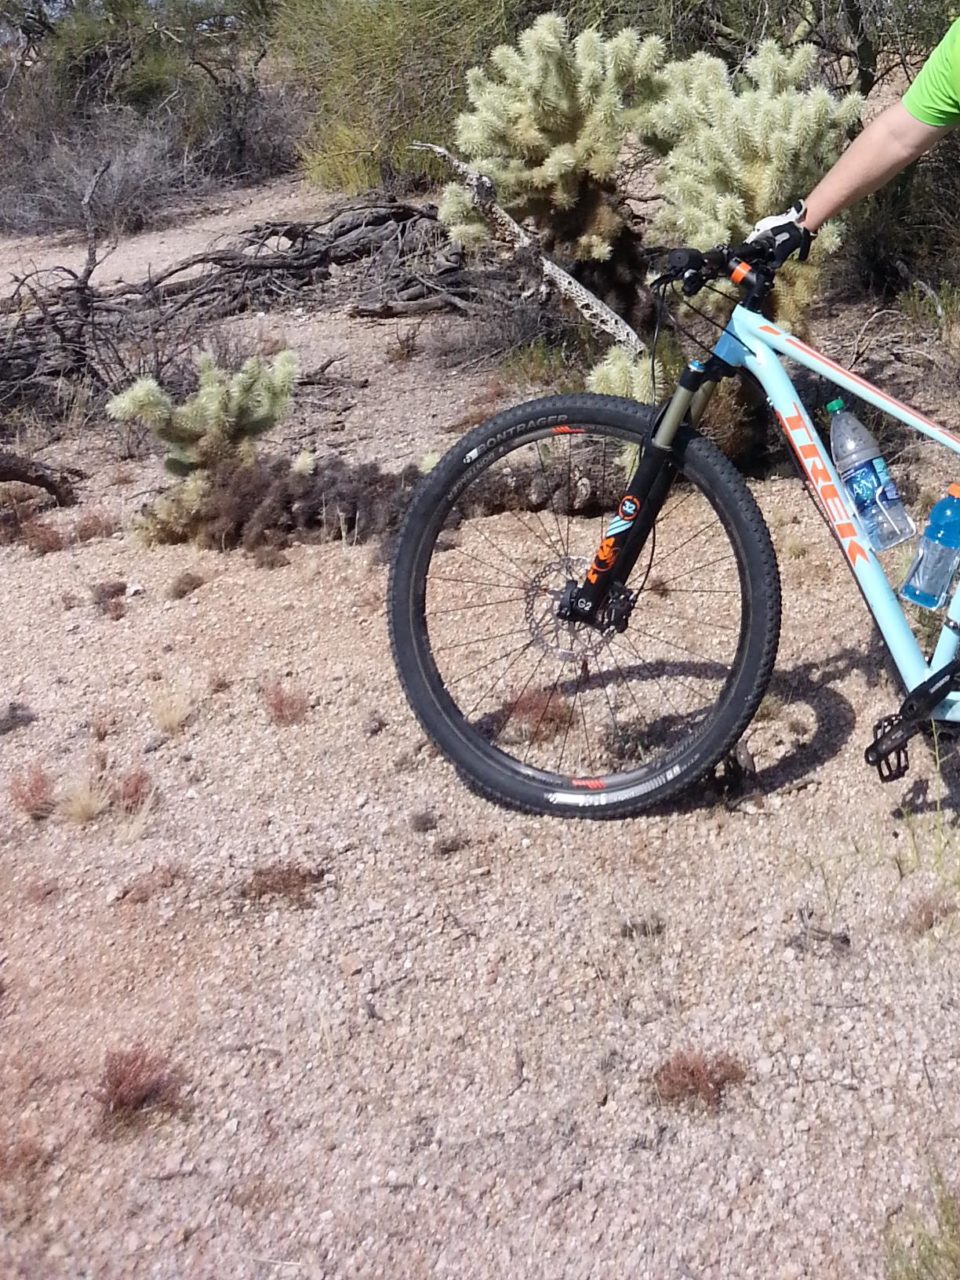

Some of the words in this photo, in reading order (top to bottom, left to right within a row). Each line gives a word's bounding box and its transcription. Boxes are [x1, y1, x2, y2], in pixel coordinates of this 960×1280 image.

[476, 413, 569, 455] BONTRAGER
[785, 401, 870, 567] TREK
[621, 500, 637, 515] 32
[577, 598, 593, 612] G2
